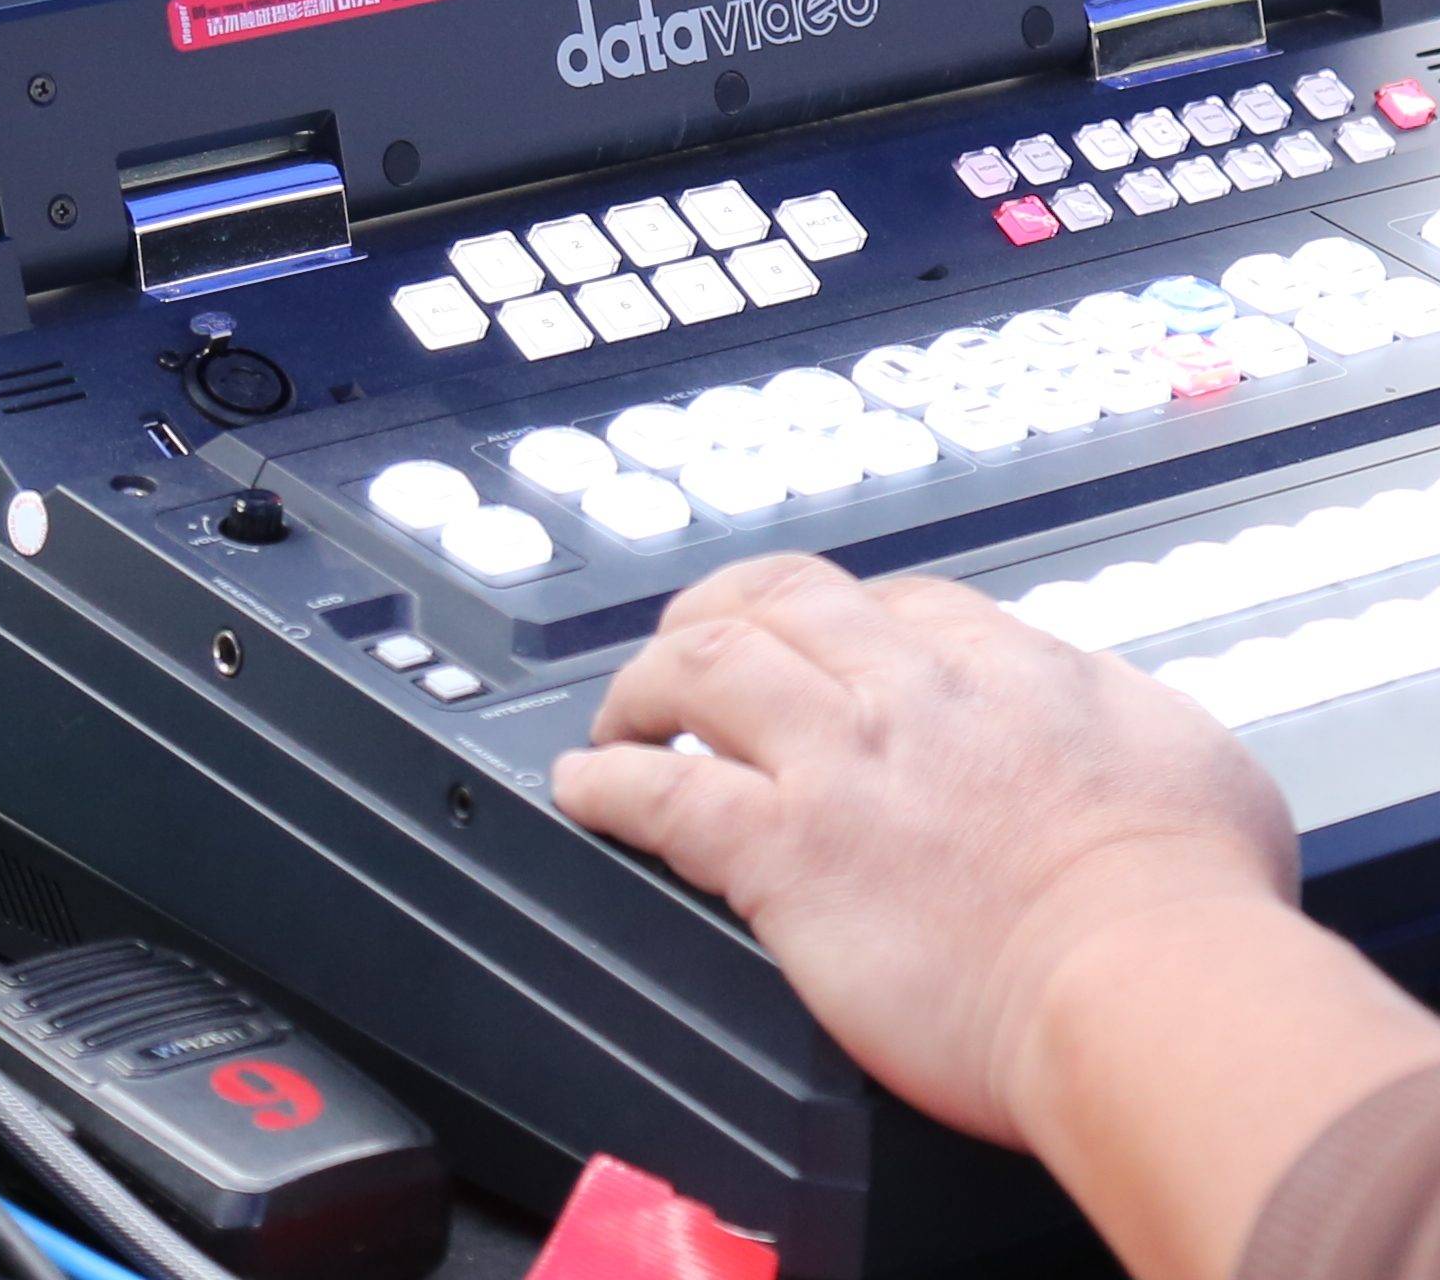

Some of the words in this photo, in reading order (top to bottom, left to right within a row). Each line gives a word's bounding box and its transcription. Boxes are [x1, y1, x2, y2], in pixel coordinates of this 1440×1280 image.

[806, 214, 842, 228] MUTE
[648, 223, 659, 232] 3
[572, 240, 583, 249] 2
[621, 300, 631, 310] 6
[542, 318, 554, 328] 5
[212, 575, 286, 628] HEADPHONE
[307, 594, 345, 610] LCD
[479, 690, 571, 721] INTERCOM
